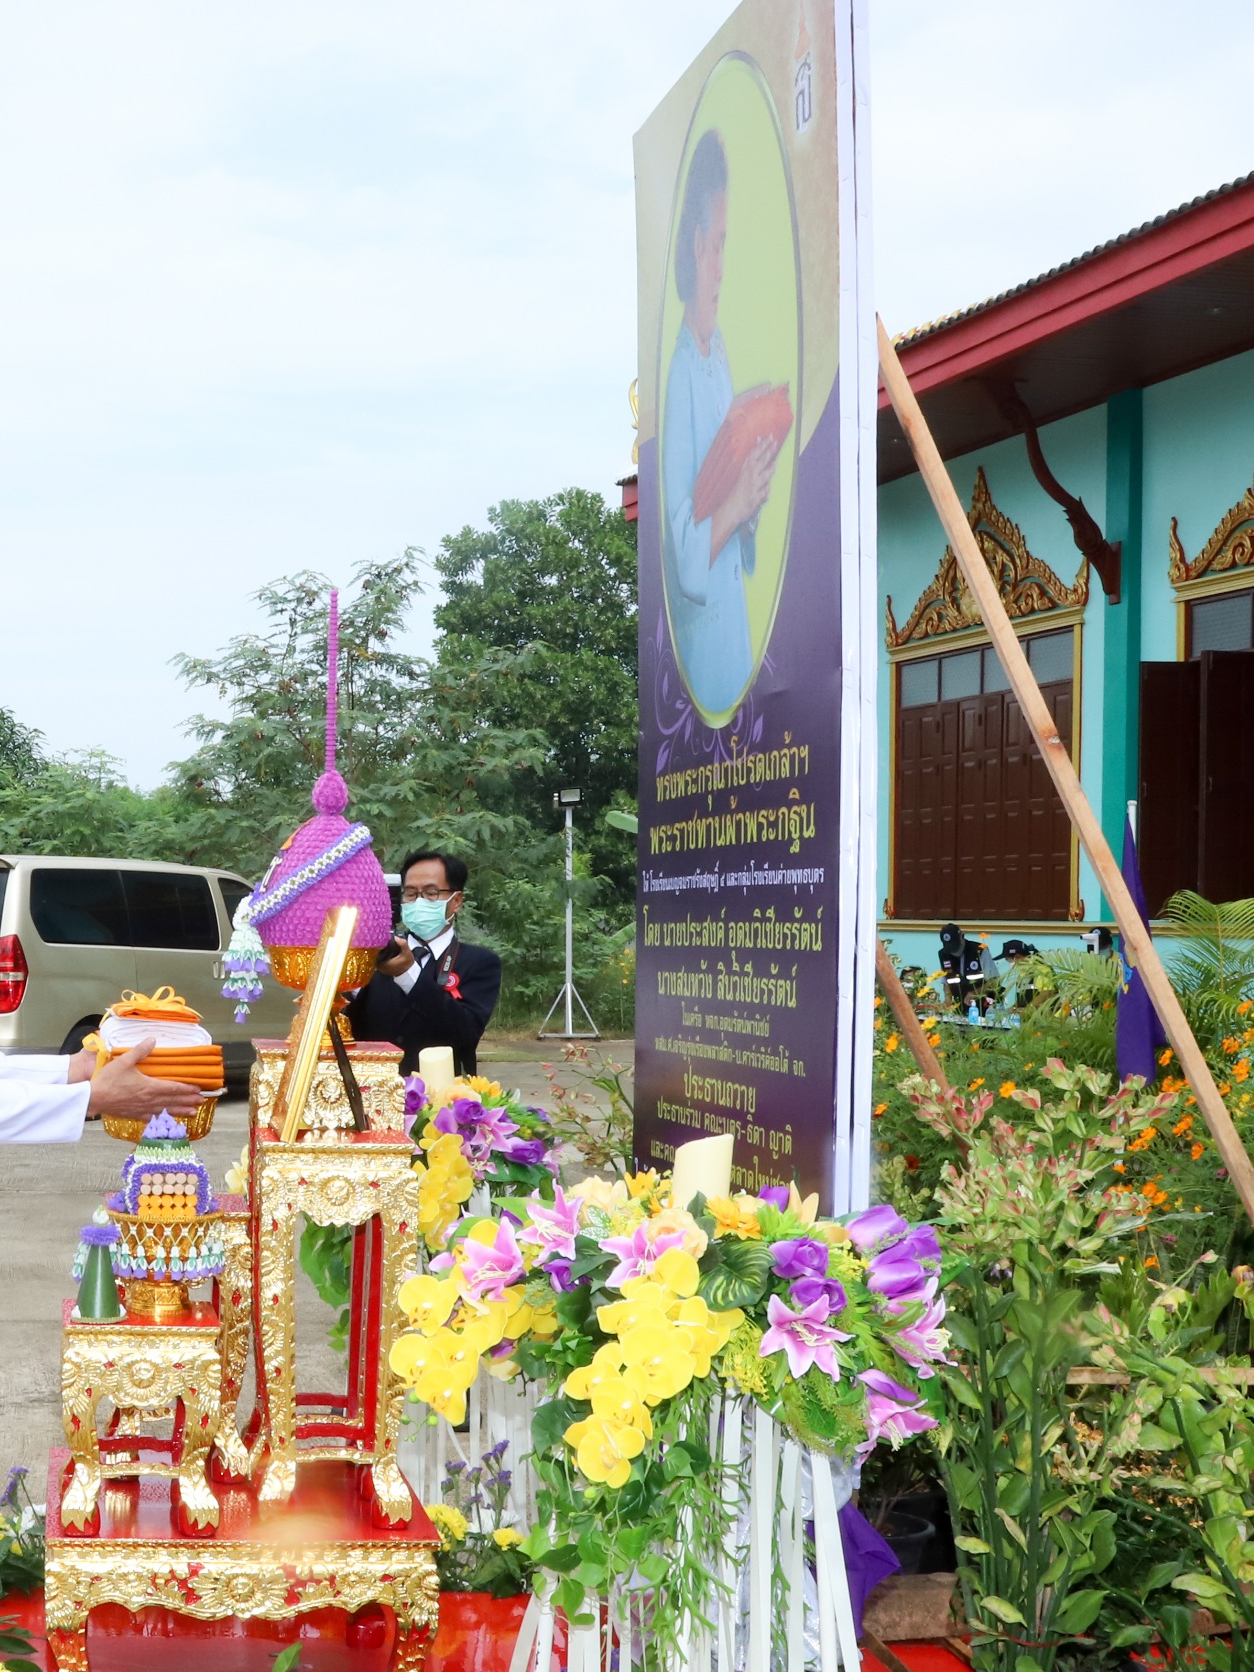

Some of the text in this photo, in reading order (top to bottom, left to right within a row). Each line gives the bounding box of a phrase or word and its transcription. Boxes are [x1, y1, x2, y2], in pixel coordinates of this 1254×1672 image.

[655, 730, 810, 812] ทรงพระกรุณาโปรดเกล้าฯ
[649, 787, 816, 856] พระราชทานผ้าพระกฐิน
[642, 904, 661, 947] โดย
[663, 905, 726, 948] นายประสงค์
[657, 959, 713, 999] นางสมหวัง
[683, 1064, 757, 1114] ประธานถวาย
[656, 1096, 701, 1129] ประธานร่วม
[768, 1124, 793, 1160] ญาติ
